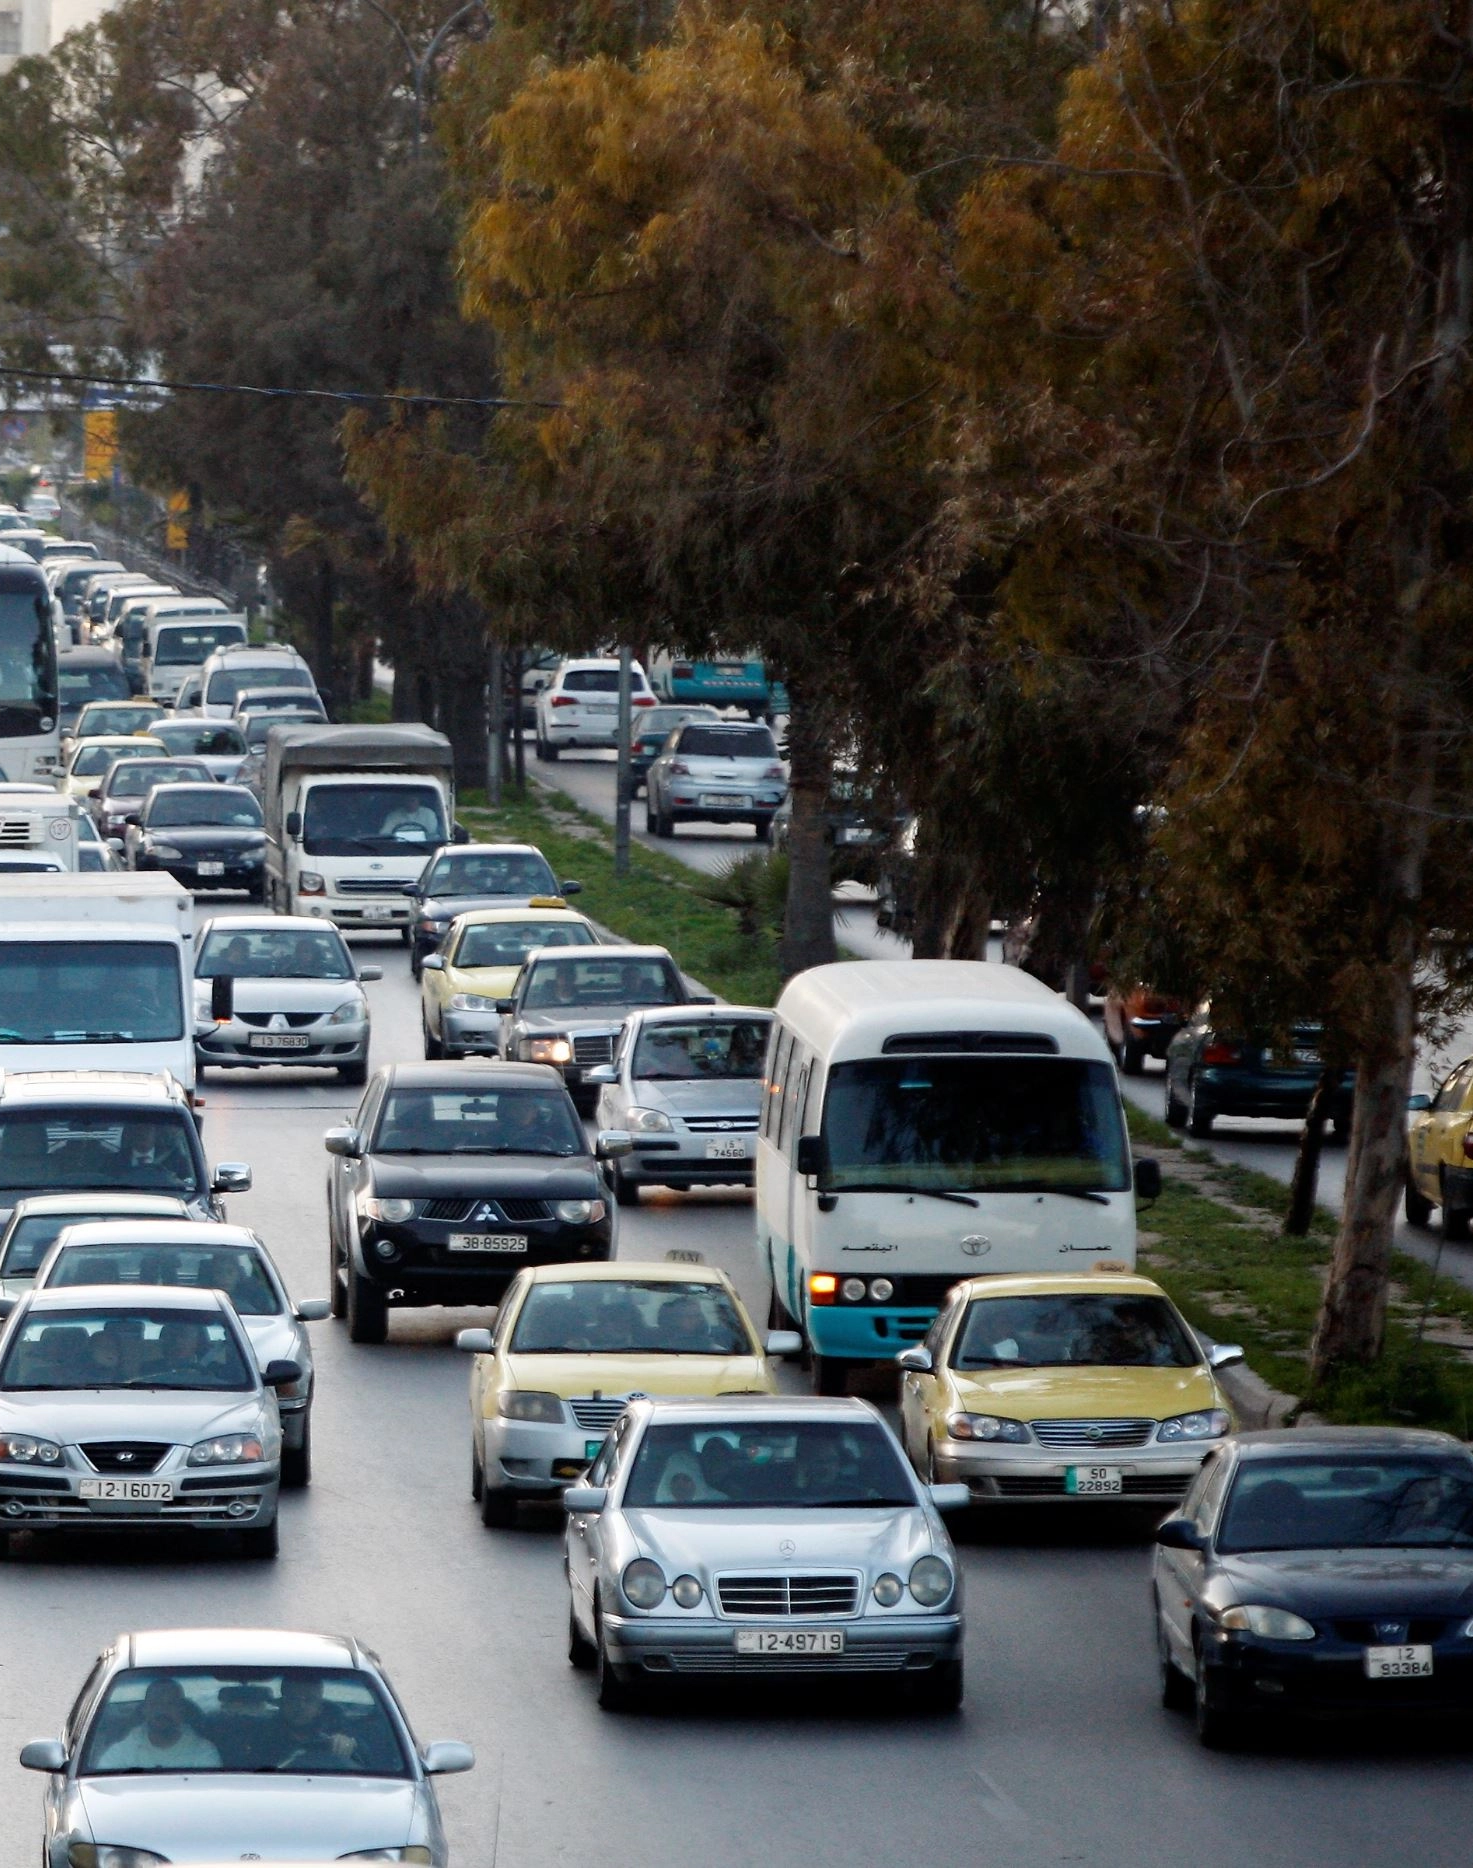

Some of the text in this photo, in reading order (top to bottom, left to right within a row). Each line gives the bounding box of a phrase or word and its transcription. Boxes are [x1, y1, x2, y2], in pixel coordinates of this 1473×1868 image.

[1058, 1244, 1112, 1253] عمان
[669, 1250, 699, 1263] TAXI
[98, 1482, 171, 1499] 12-16072
[1078, 1481, 1120, 1492] 22892
[758, 1634, 841, 1651] 12-49719
[1398, 1647, 1415, 1660] 12
[1380, 1661, 1431, 1676] 93384
